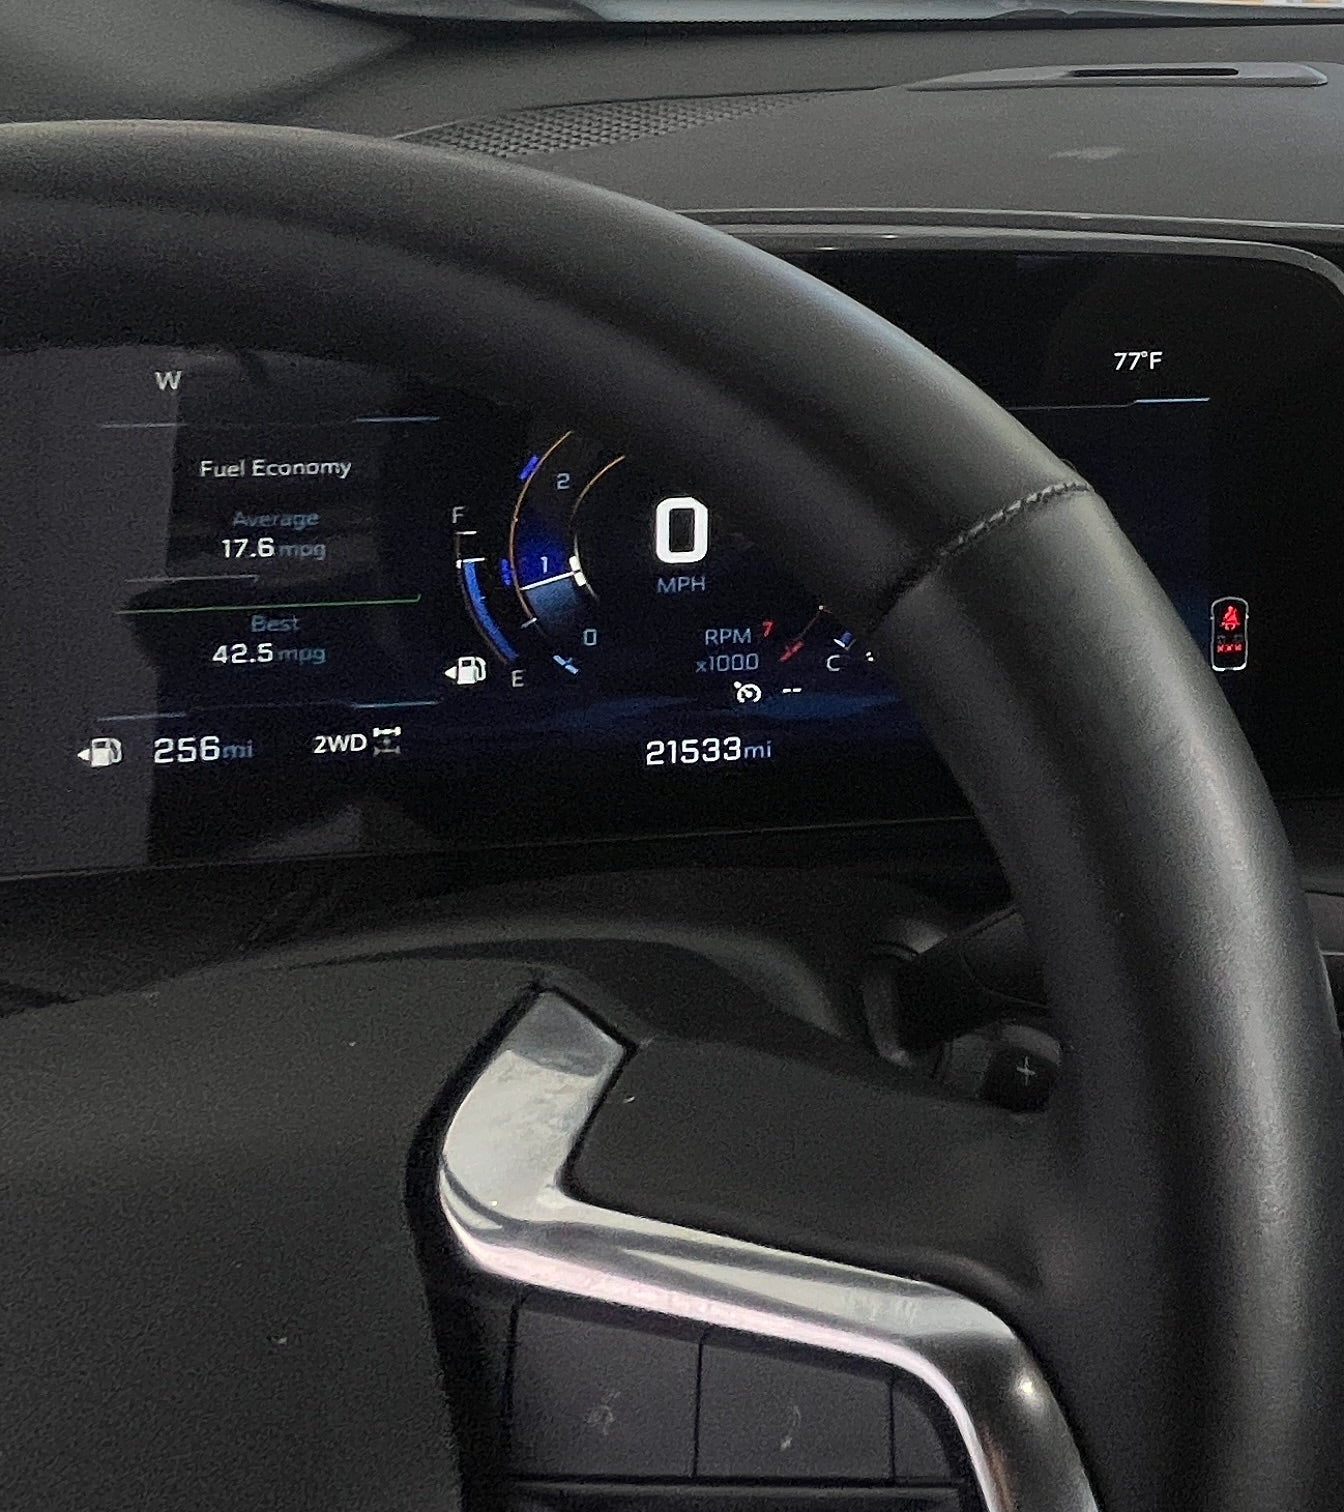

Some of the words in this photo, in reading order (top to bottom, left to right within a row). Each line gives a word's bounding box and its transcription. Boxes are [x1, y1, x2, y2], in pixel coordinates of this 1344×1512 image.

[1113, 350, 1164, 372] 77°F
[154, 370, 183, 391] W
[200, 458, 245, 479] Fuel
[251, 457, 352, 480] Economy
[556, 472, 571, 490] 2
[232, 510, 320, 532] Average
[452, 506, 466, 524] F
[654, 495, 709, 565] 0
[220, 536, 276, 559] 17.6
[656, 576, 706, 594] MPH
[251, 614, 301, 634] Best
[704, 627, 753, 647] RPM
[211, 642, 275, 665] 42.5
[695, 652, 760, 673] x1000
[825, 653, 841, 672] C
[511, 669, 525, 688] E
[312, 733, 368, 755] 2WD
